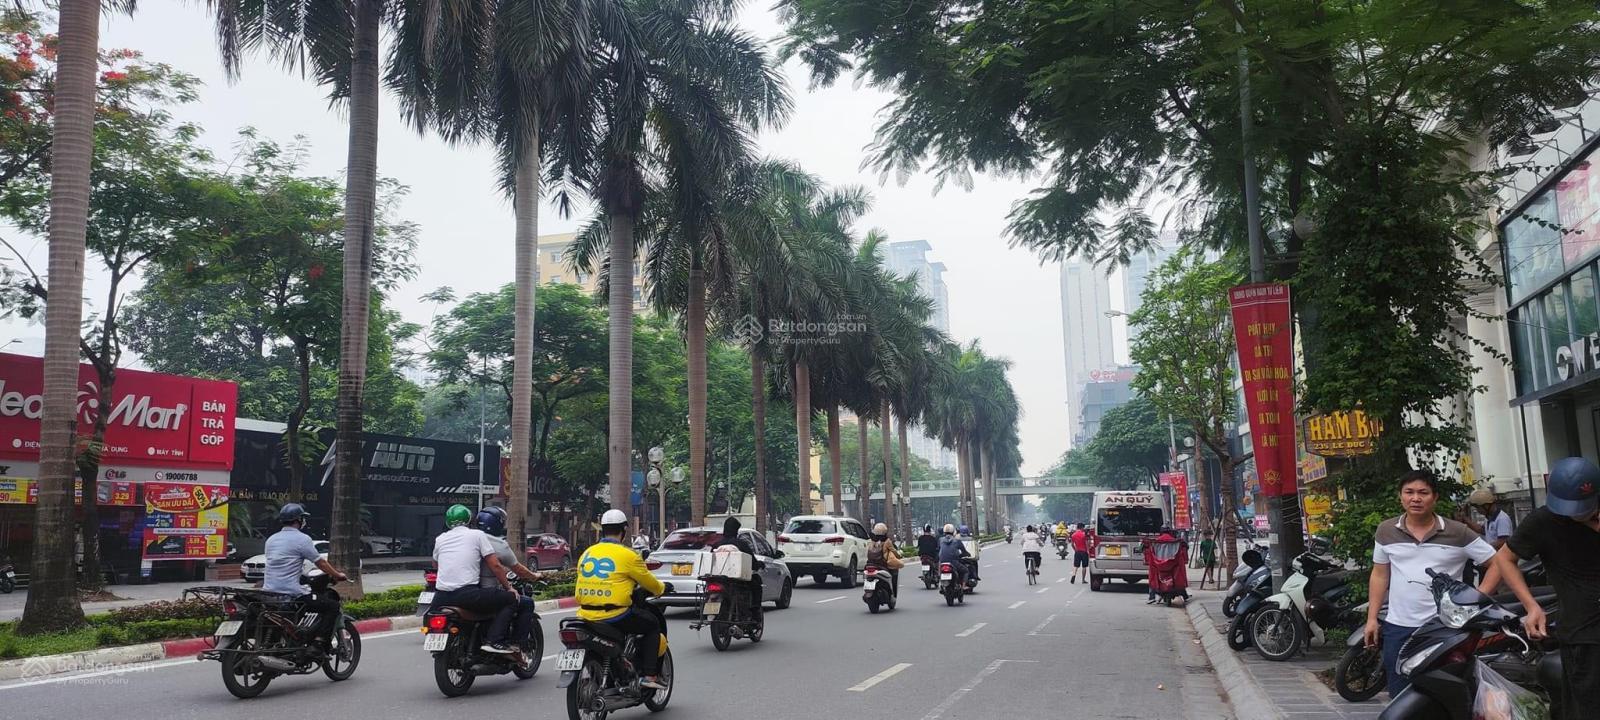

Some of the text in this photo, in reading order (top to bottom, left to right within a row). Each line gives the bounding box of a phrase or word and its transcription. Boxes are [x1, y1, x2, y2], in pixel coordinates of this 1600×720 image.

[106, 394, 184, 431] Mart
[202, 400, 226, 413] BÁN
[201, 416, 225, 429] TRẢ
[200, 432, 225, 445] GÓP
[370, 442, 435, 471] AUTO
[165, 472, 198, 481] 19006788
[581, 554, 615, 578] be
